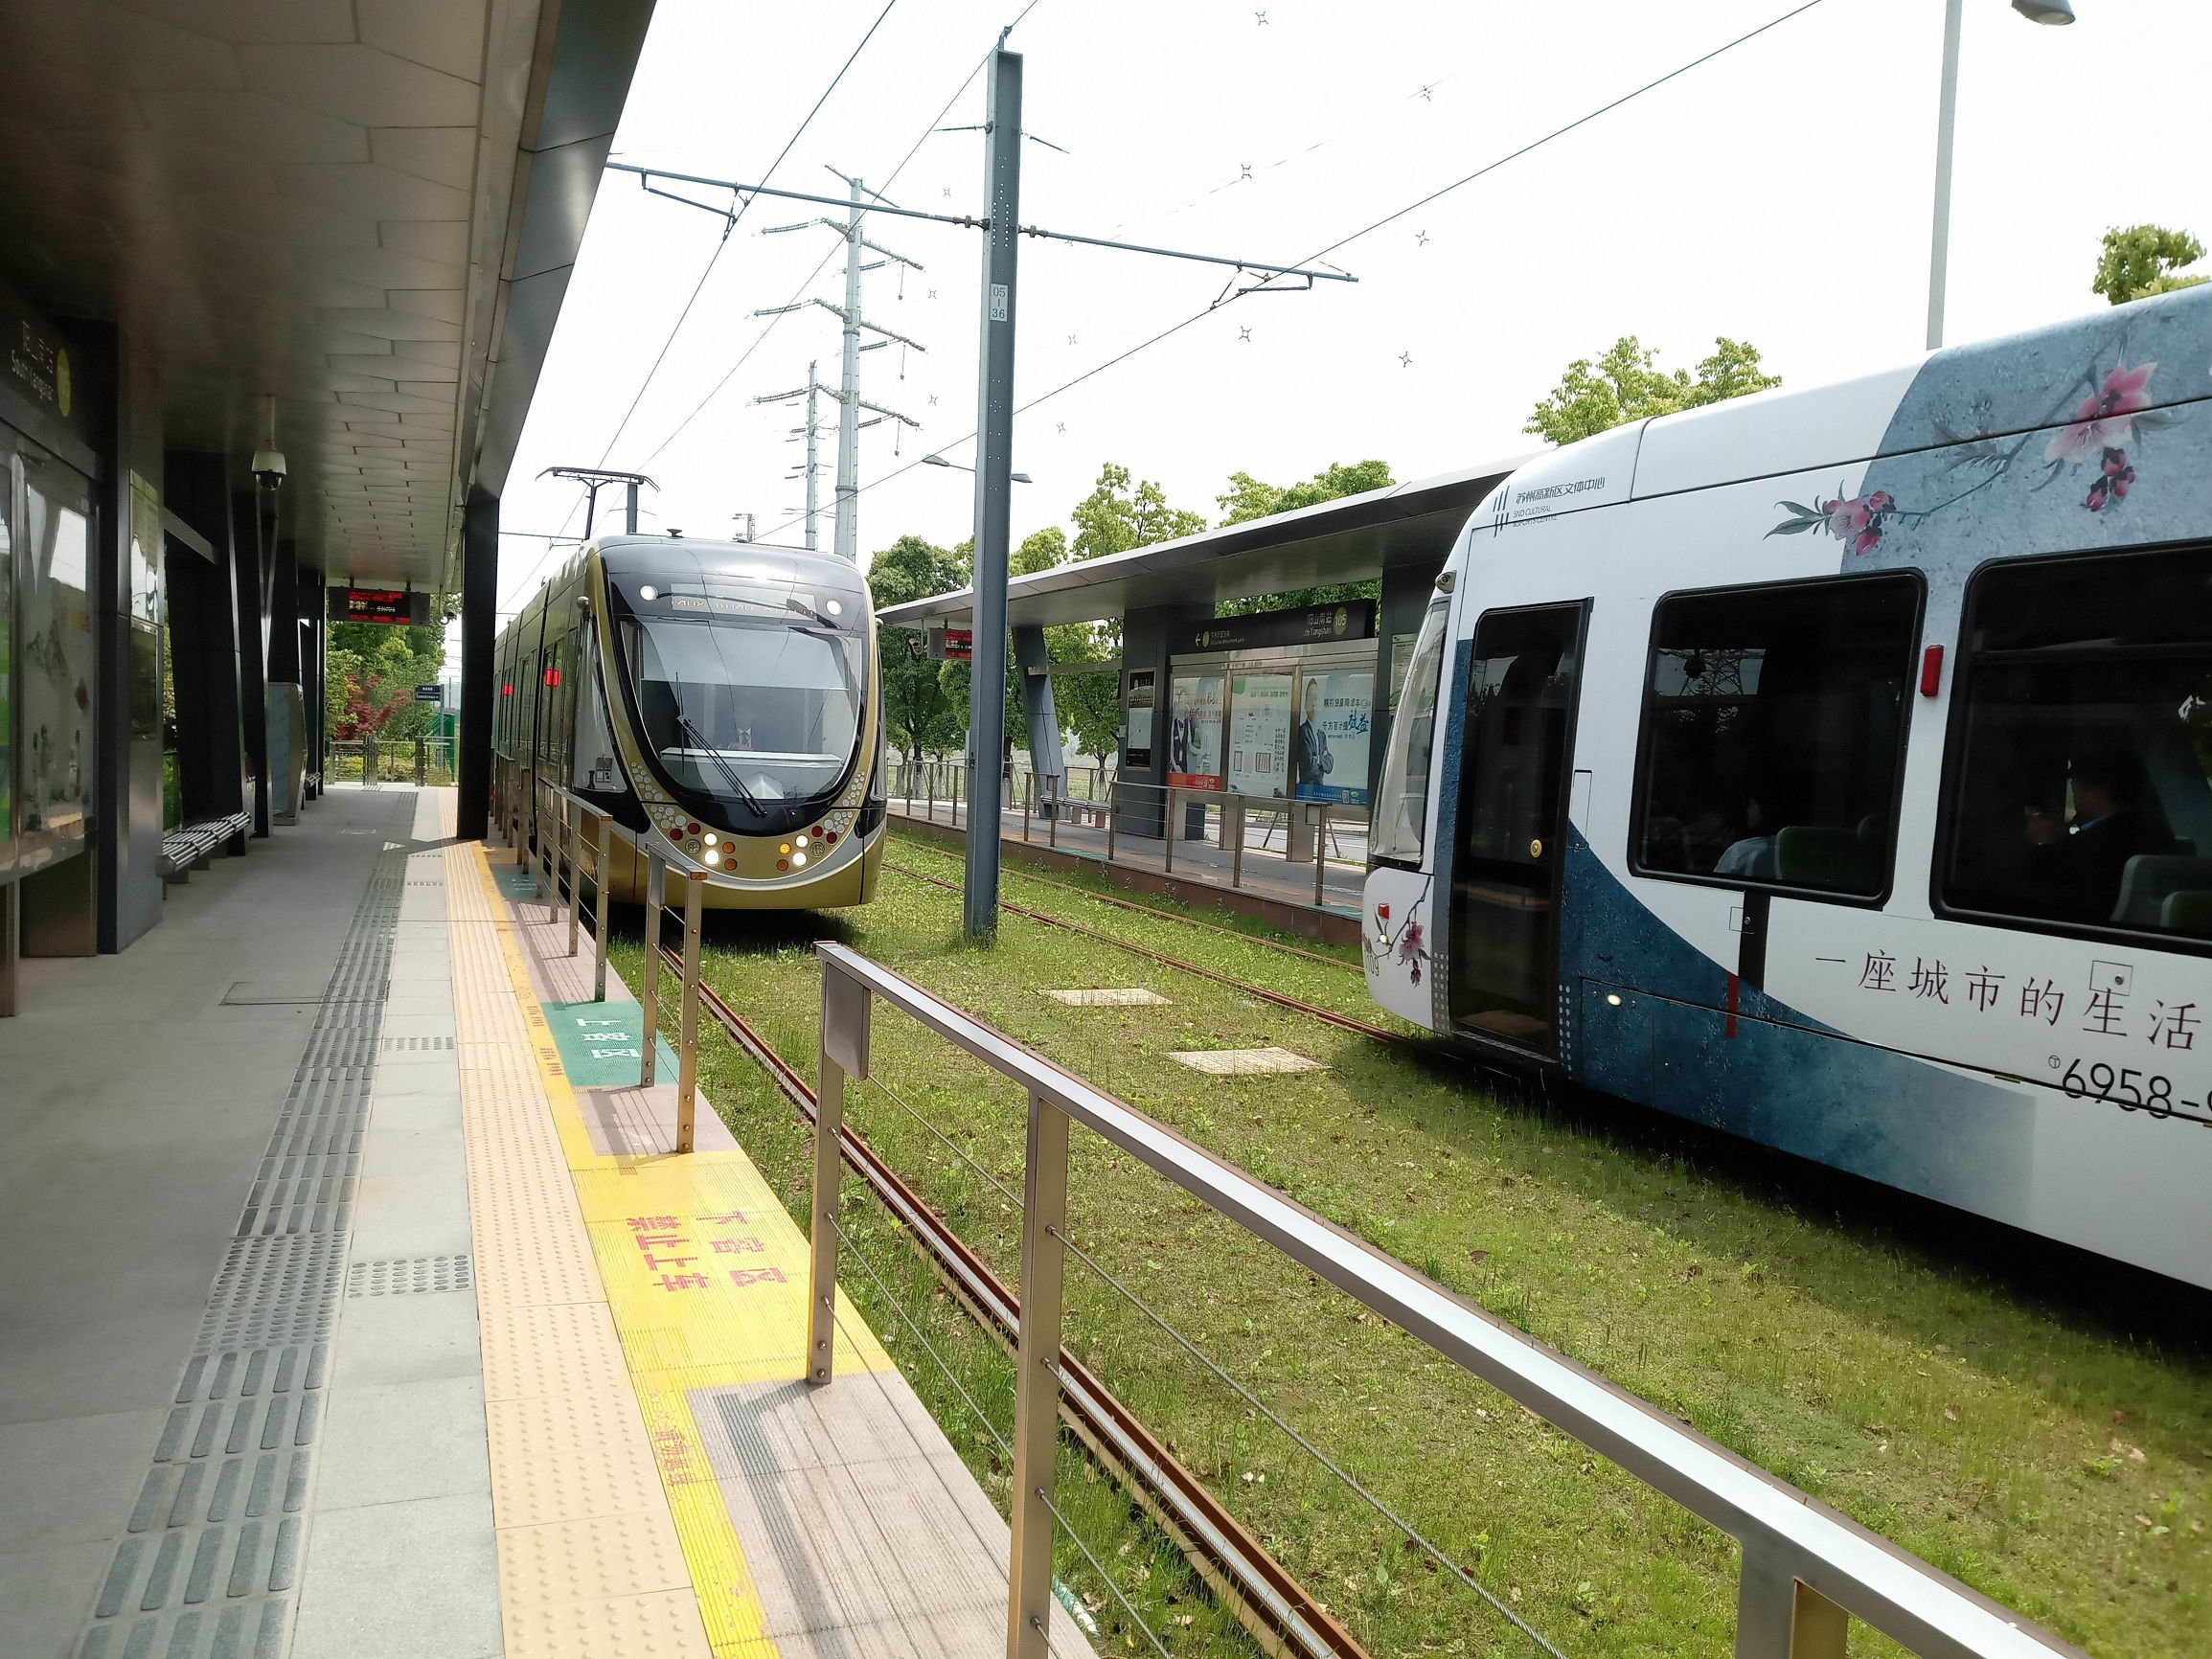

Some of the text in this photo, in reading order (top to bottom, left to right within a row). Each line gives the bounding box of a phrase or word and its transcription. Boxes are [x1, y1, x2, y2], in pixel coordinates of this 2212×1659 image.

[992, 286, 1006, 298] 05
[992, 307, 1005, 319] 36
[1515, 476, 1606, 505] 苏州高新区文体中心
[1334, 614, 1347, 626] 105
[1814, 949, 2202, 1050] 一座城市的生活
[2062, 1058, 2212, 1119] 6958-
[626, 1214, 709, 1293] 禁止上车
[696, 1210, 787, 1287] 下客区
